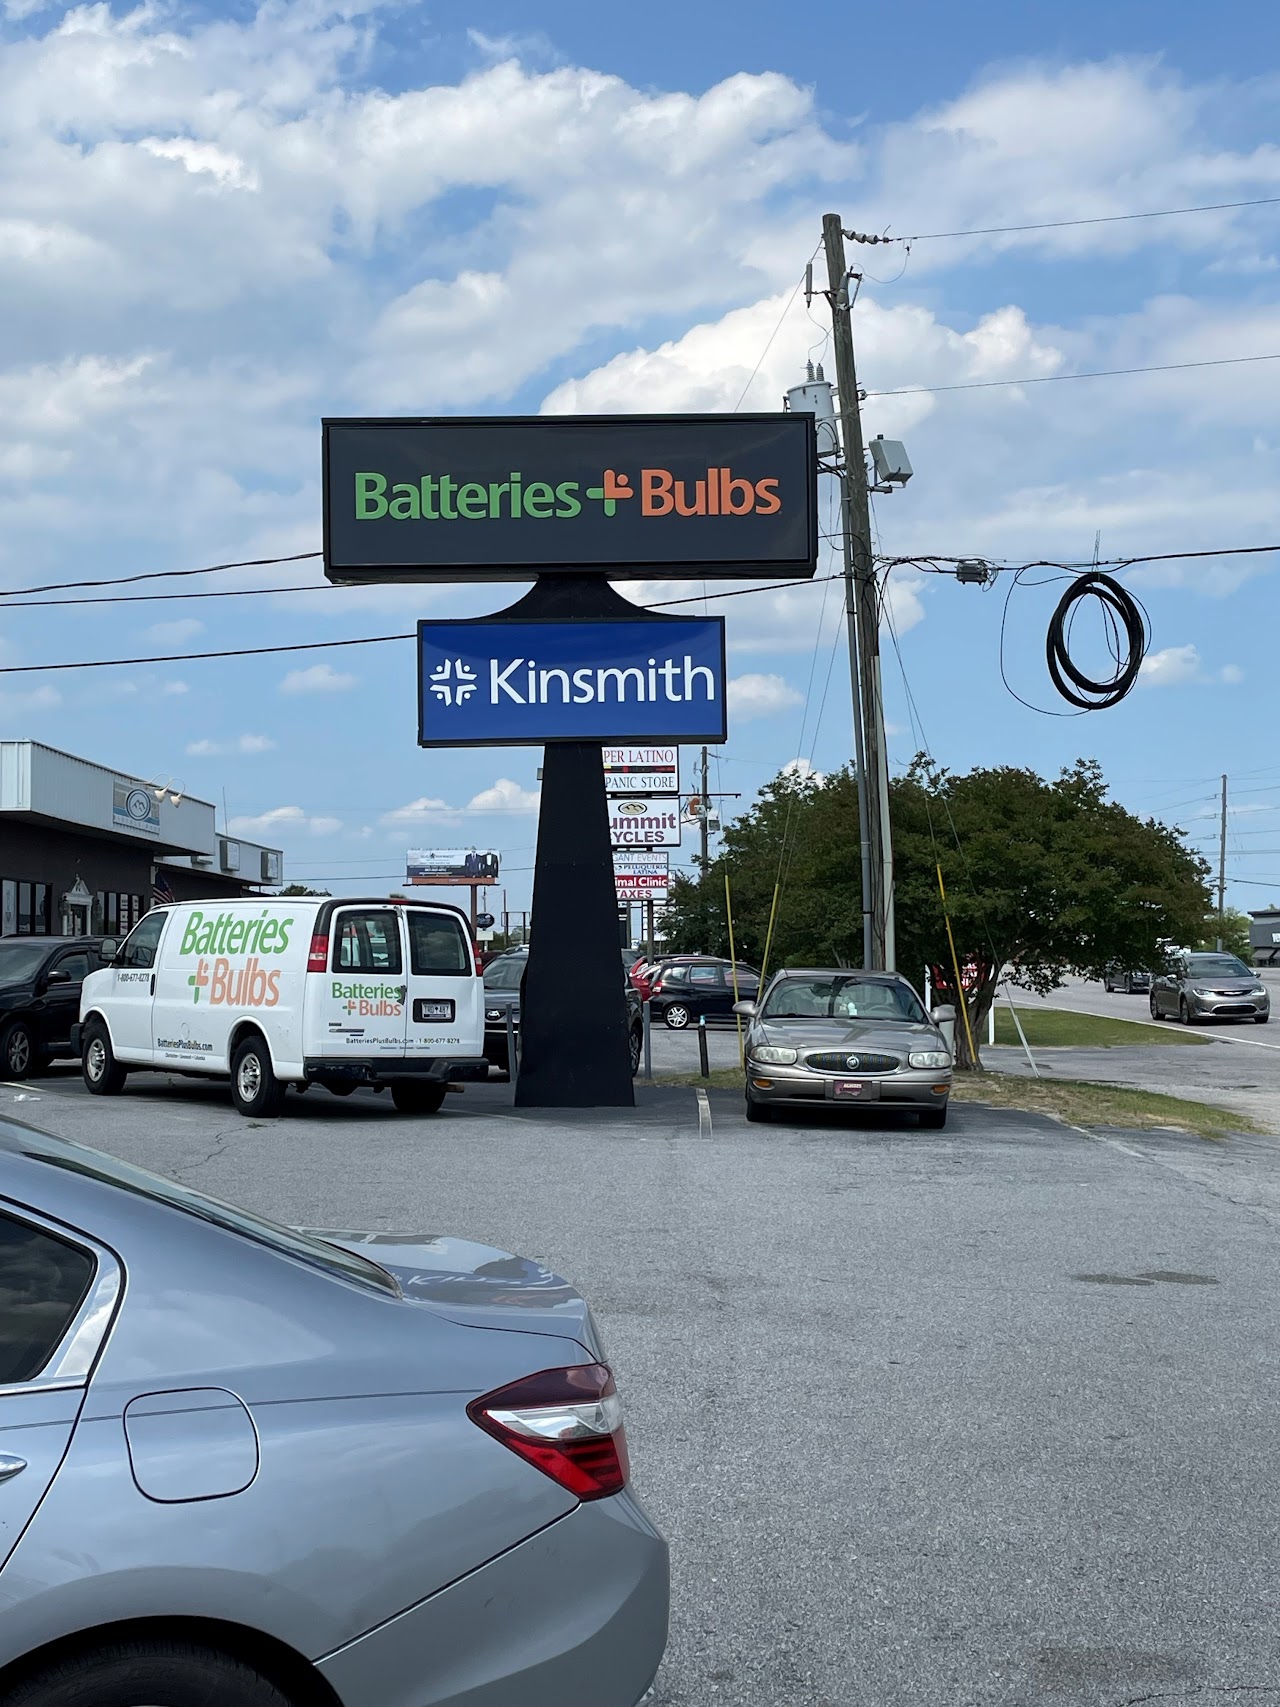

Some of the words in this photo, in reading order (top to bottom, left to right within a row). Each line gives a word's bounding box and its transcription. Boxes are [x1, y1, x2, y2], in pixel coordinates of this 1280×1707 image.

[355, 472, 581, 519] Batteries
[641, 468, 782, 517] Bulbs
[490, 656, 715, 704] Kinsmith
[629, 750, 674, 763] LATINO
[641, 776, 674, 788] STORE
[611, 831, 665, 843] YCLES
[637, 853, 667, 862] EVENTS
[638, 877, 668, 887] Clinic
[179, 910, 294, 955] Batteries
[209, 958, 282, 1007] Bulbs
[332, 982, 404, 999] Batteries
[359, 1000, 402, 1016] Bulbs
